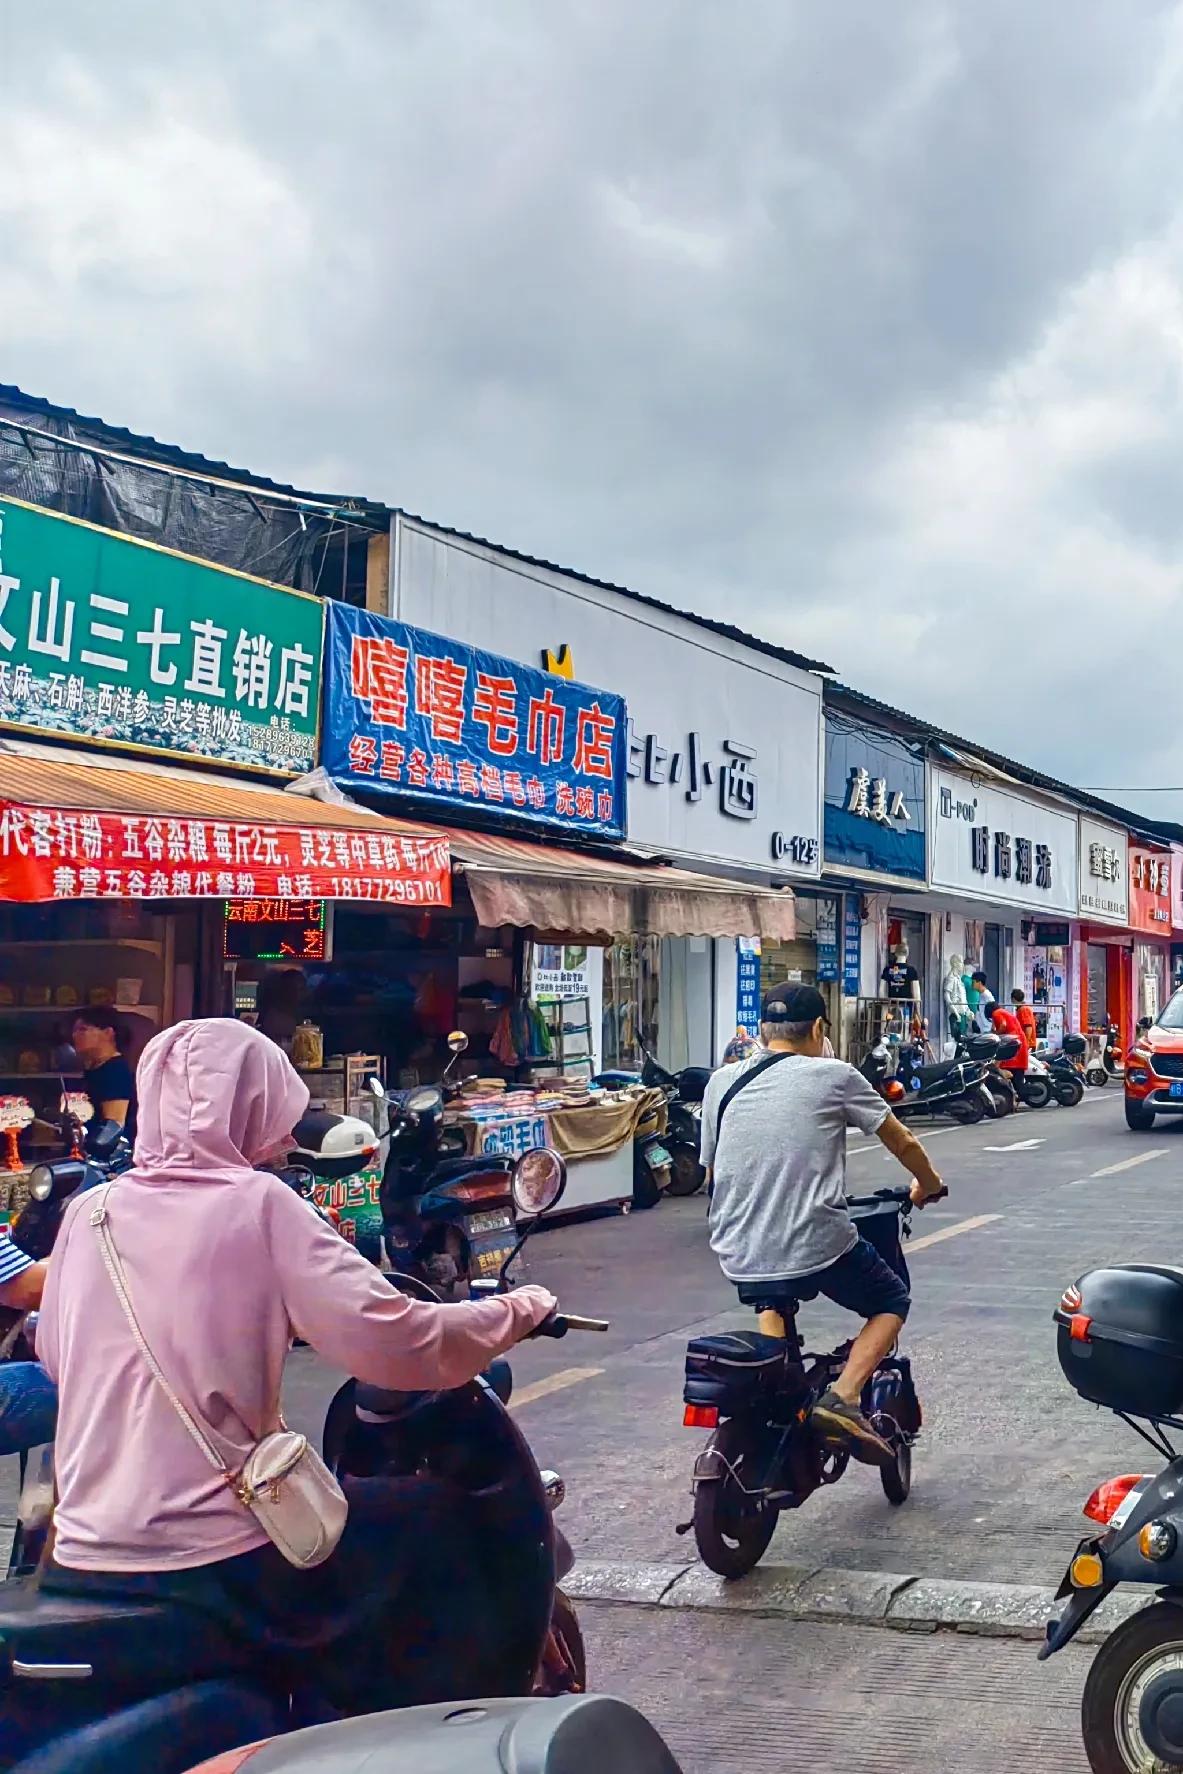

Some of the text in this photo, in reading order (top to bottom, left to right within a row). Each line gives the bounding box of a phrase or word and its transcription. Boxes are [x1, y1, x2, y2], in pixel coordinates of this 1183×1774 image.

[351, 634, 616, 780] 嘻嘻毛巾店
[972, 826, 1052, 888] 时尚潮流
[228, 898, 321, 922] 云南文山三七
